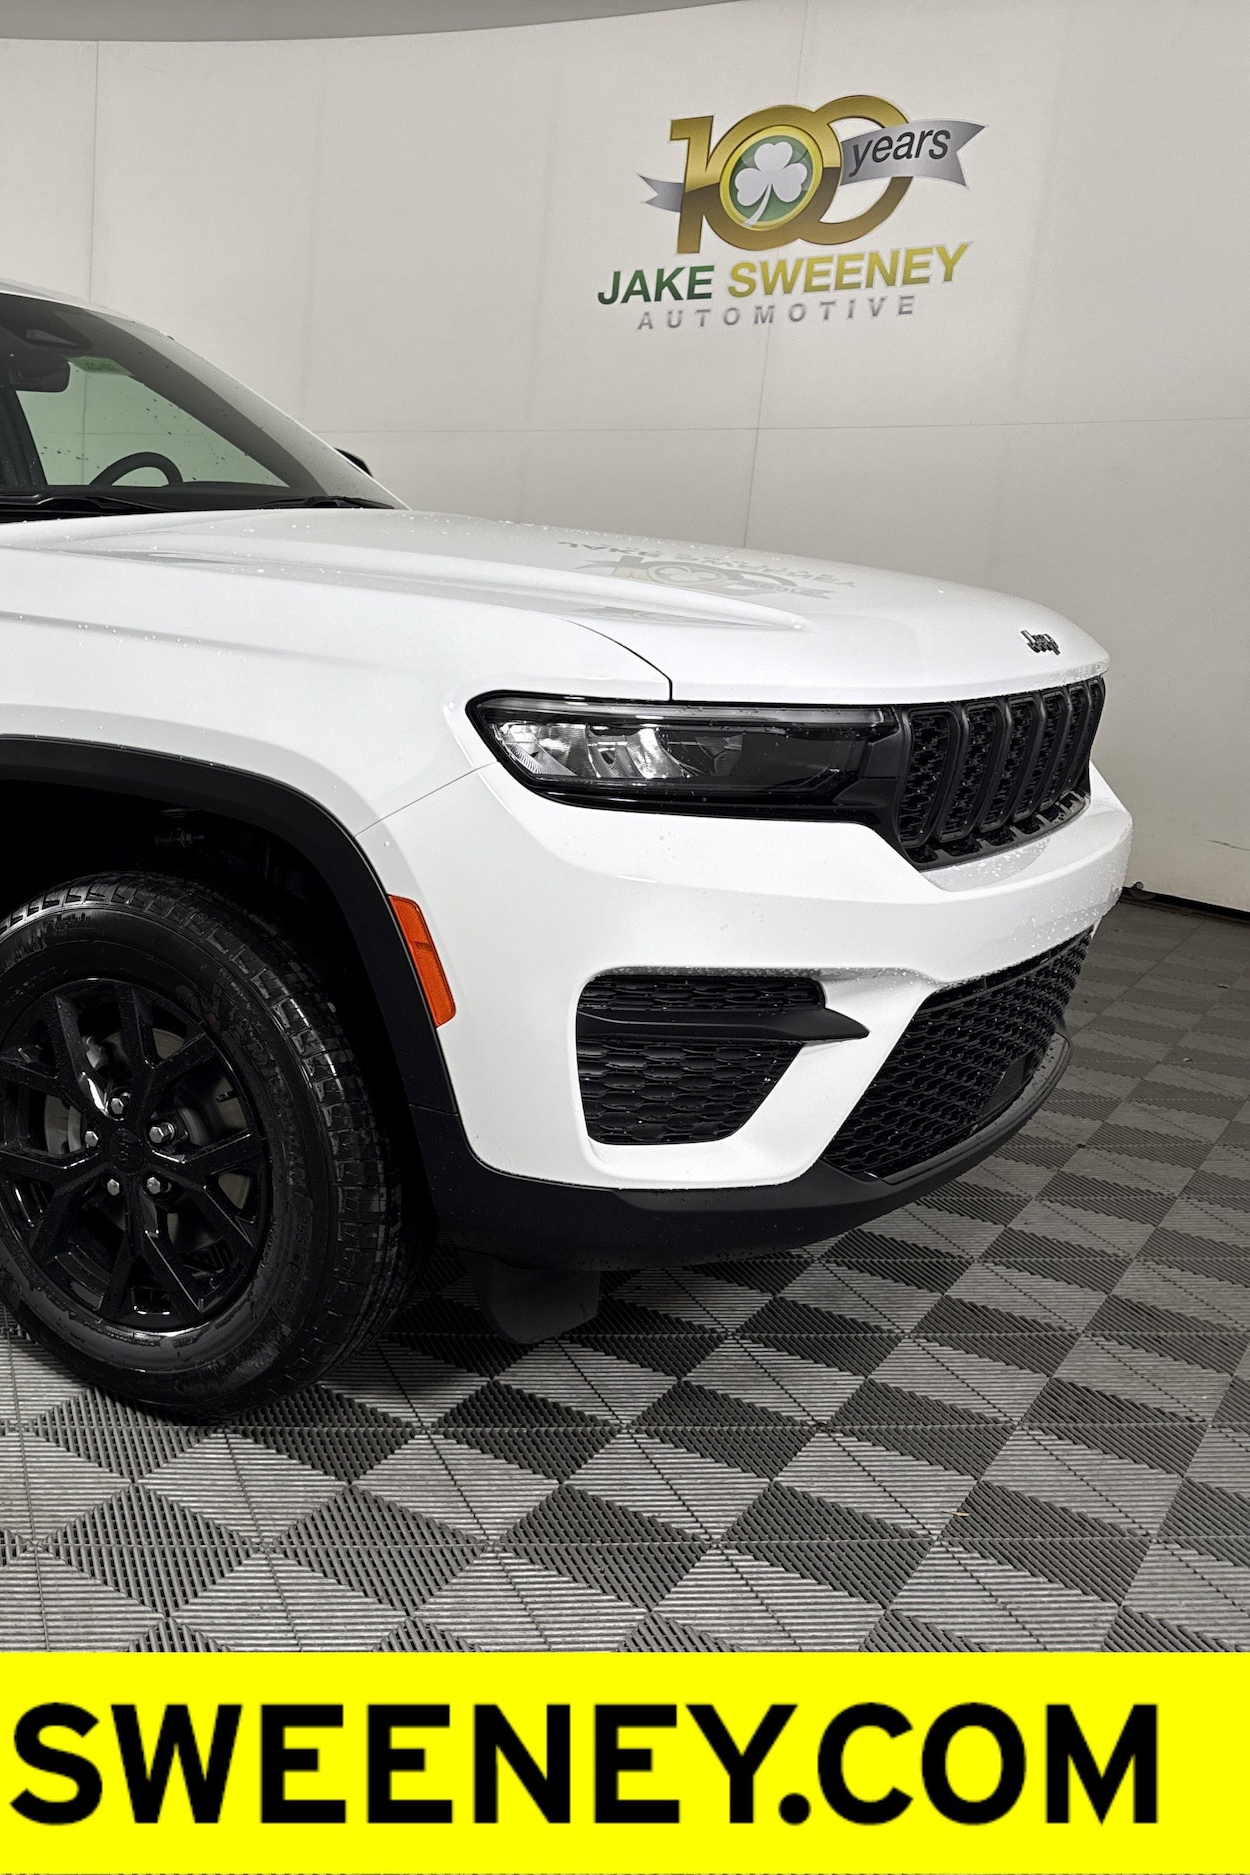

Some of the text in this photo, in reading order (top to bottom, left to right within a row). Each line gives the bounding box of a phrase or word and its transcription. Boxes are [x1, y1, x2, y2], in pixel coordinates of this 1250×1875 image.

[849, 126, 951, 177] years
[598, 243, 969, 304] JAKE SWEENEY
[637, 296, 915, 330] AUTOMOTIVE
